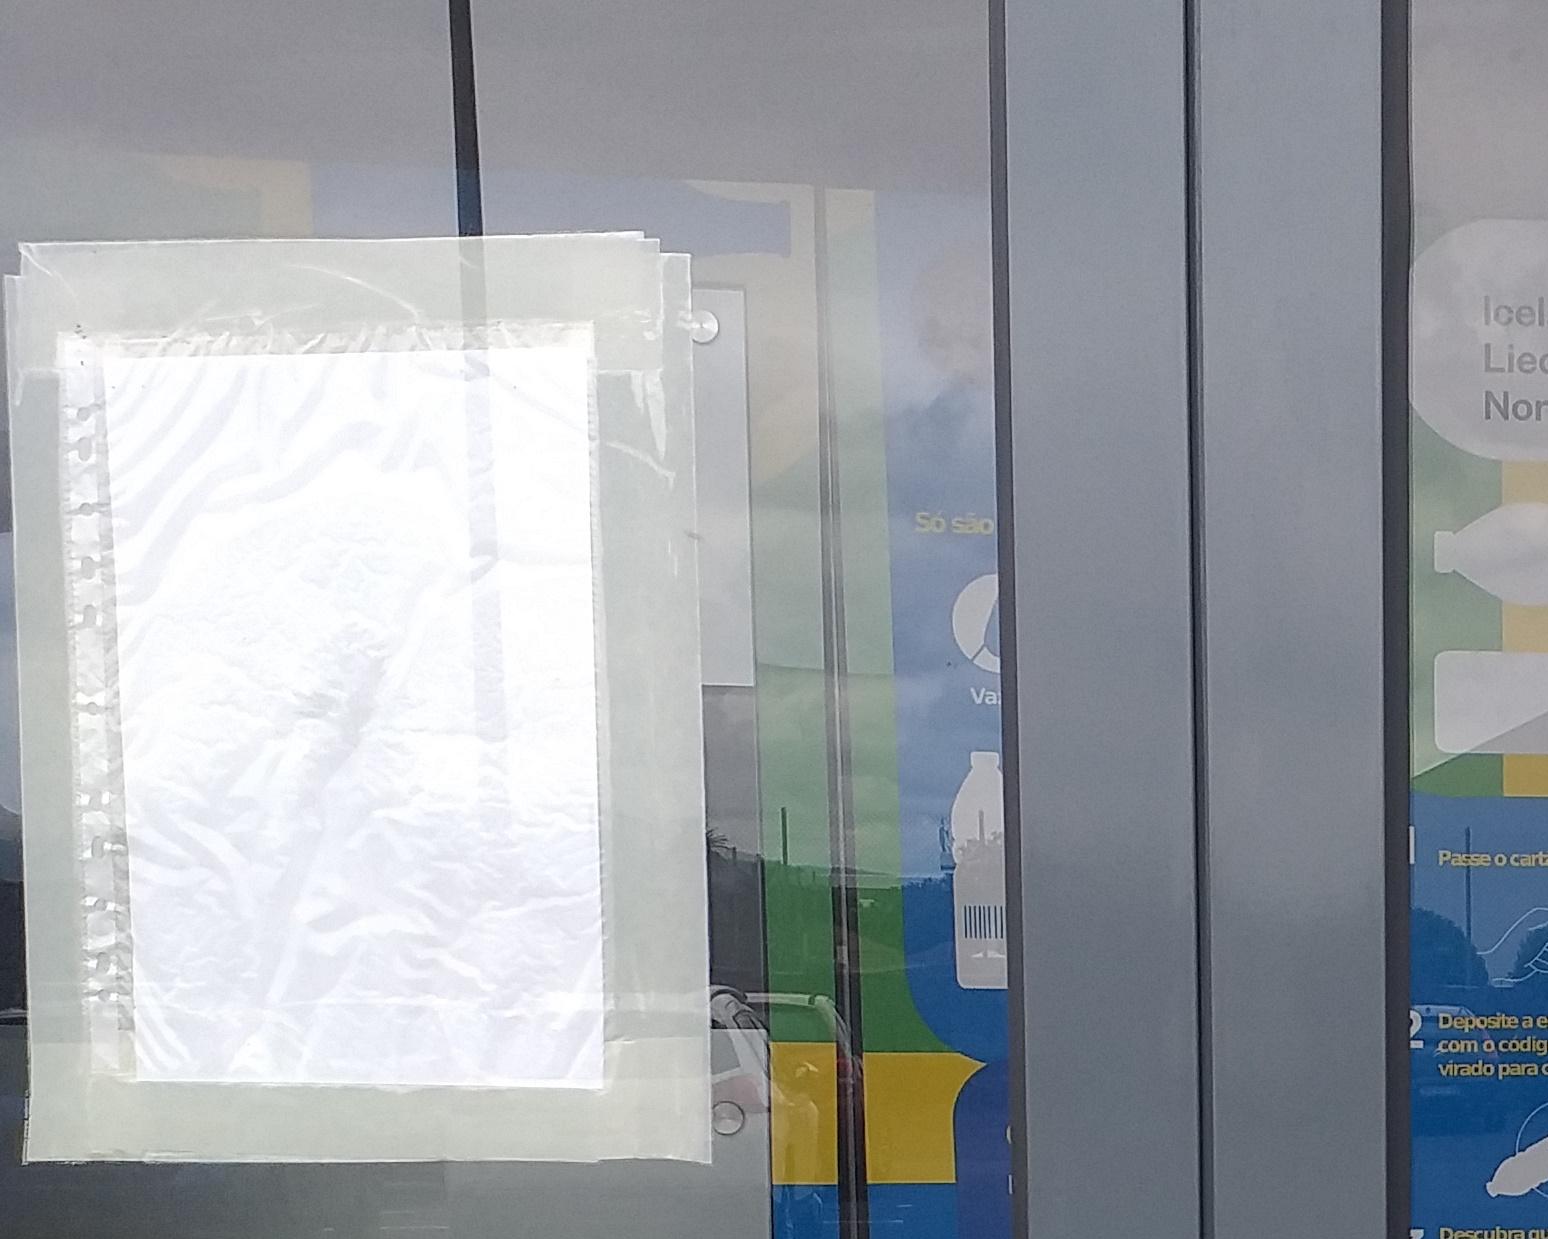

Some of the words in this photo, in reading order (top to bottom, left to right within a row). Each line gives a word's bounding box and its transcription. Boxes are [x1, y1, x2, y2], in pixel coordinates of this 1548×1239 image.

[914, 512, 945, 533] Só
[951, 513, 995, 535] são
[970, 688, 1002, 705] Va
[1438, 851, 1491, 867] Passe
[1495, 854, 1507, 867] o
[1438, 1012, 1519, 1033] Deposite
[1521, 1016, 1534, 1029] a
[1438, 1039, 1478, 1053] com
[1483, 1039, 1495, 1052] o
[1438, 1060, 1494, 1077] virado
[1498, 1063, 1538, 1080] para
